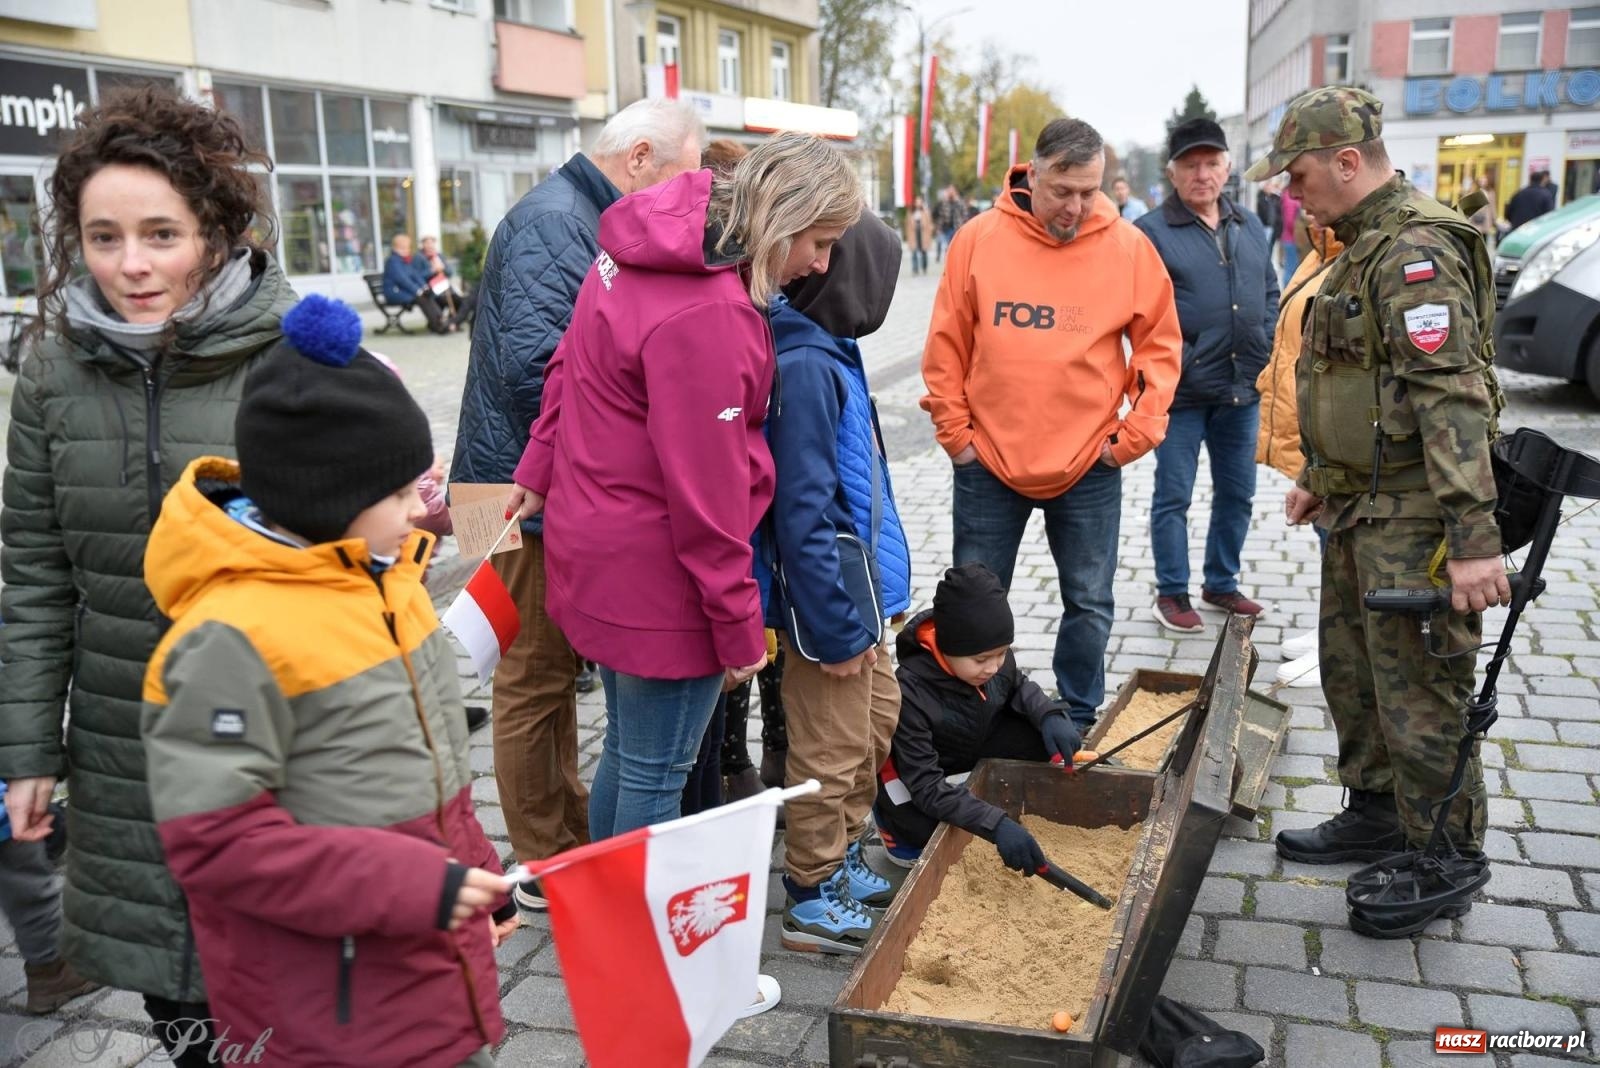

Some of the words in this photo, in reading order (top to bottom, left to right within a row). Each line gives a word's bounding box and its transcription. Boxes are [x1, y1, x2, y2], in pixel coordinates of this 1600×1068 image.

[1405, 70, 1600, 113] BOLKO
[0, 83, 86, 136] mpik
[993, 301, 1056, 330] FOB
[1059, 305, 1085, 316] FREE
[1058, 323, 1094, 335] BOARD
[717, 407, 742, 421] 4F
